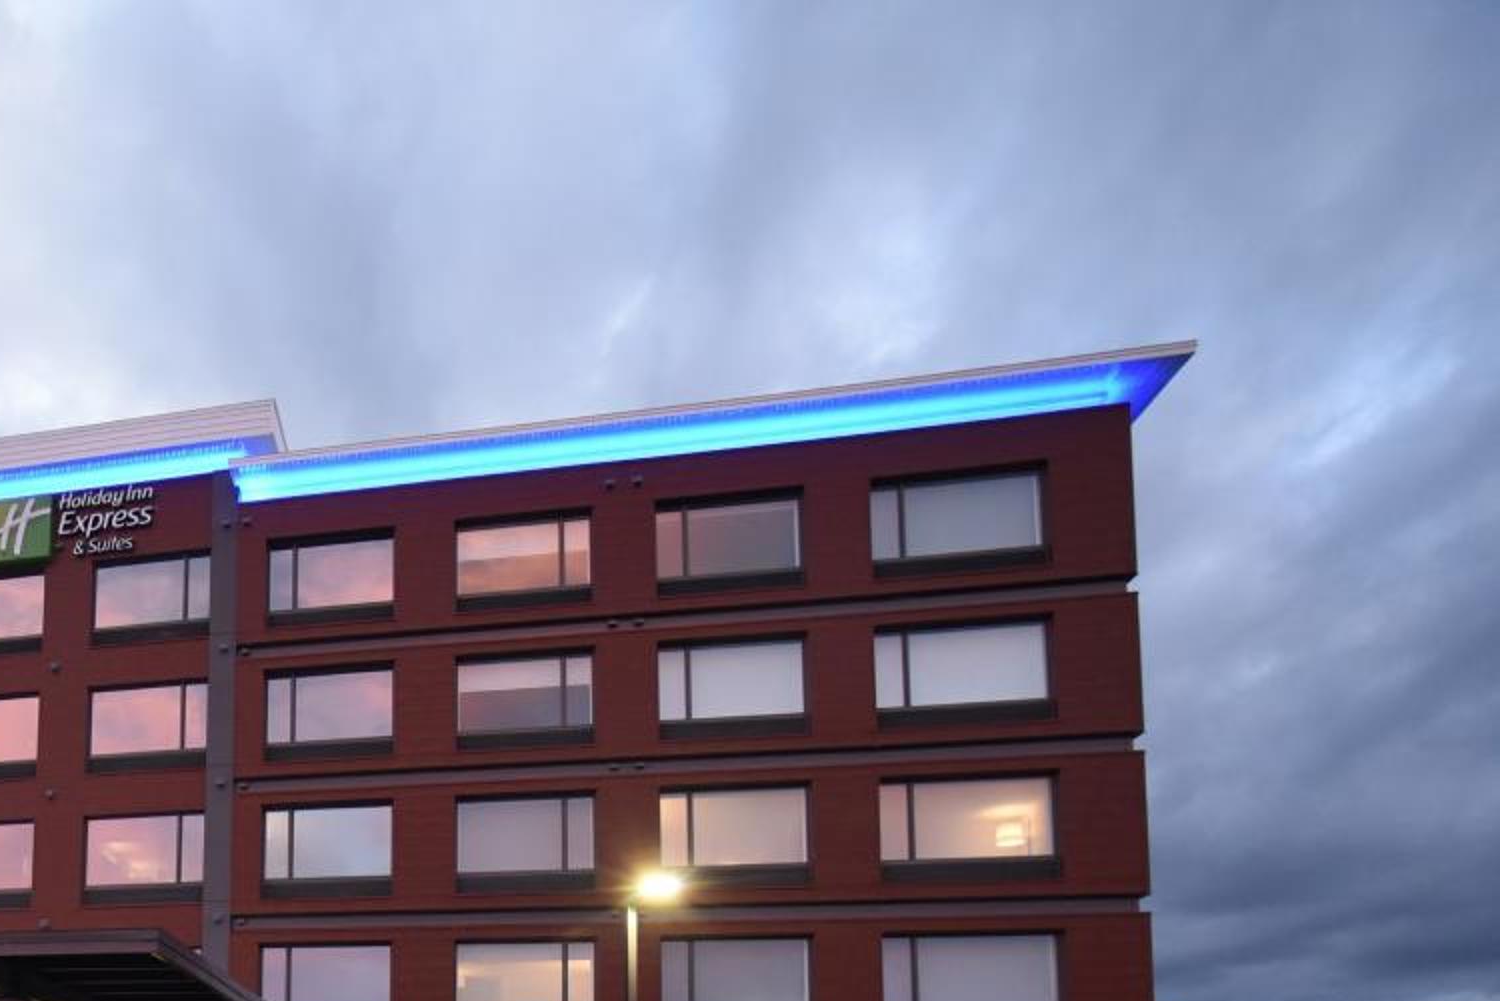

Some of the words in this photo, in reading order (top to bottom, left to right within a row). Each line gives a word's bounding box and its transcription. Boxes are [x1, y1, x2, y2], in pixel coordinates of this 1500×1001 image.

[59, 490, 123, 509] Holiday
[124, 485, 153, 501] Inn
[58, 506, 152, 537] Express
[73, 540, 84, 555] &
[88, 536, 133, 552] Suites
